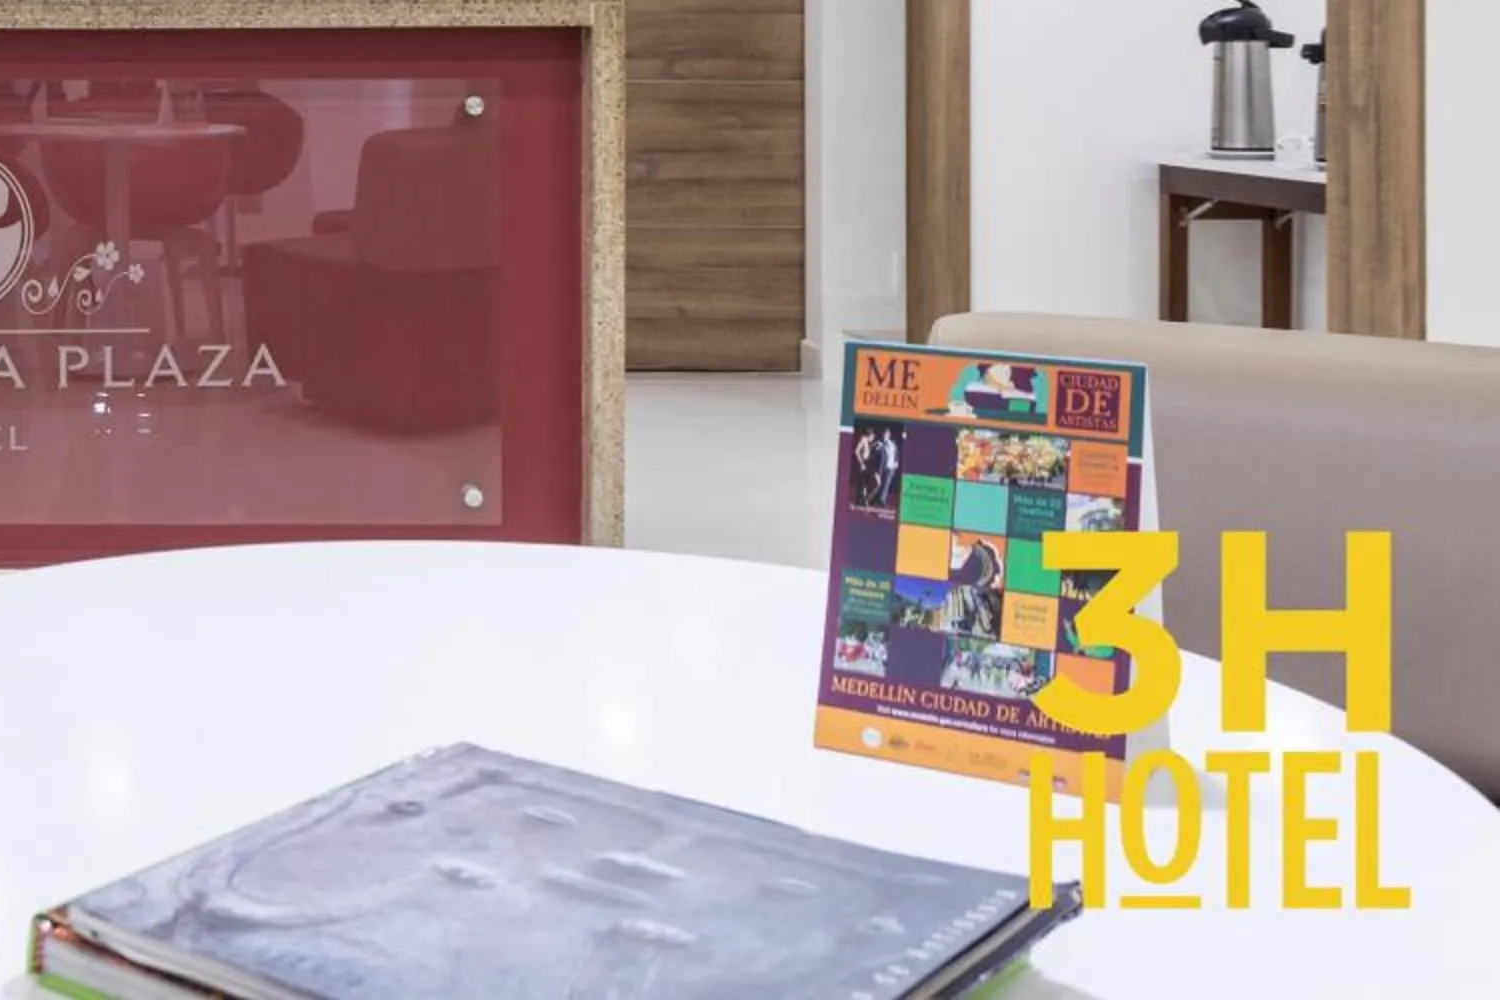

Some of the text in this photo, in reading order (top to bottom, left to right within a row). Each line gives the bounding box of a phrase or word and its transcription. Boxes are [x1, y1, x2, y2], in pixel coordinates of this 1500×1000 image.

[56, 342, 287, 389] PLAZA
[865, 355, 921, 391] ME
[1059, 374, 1119, 391] CIUDAD
[1065, 388, 1113, 417] DE
[1059, 415, 1117, 430] ARTISTAS
[920, 693, 990, 718] CIUDAD
[996, 707, 1021, 724] DE
